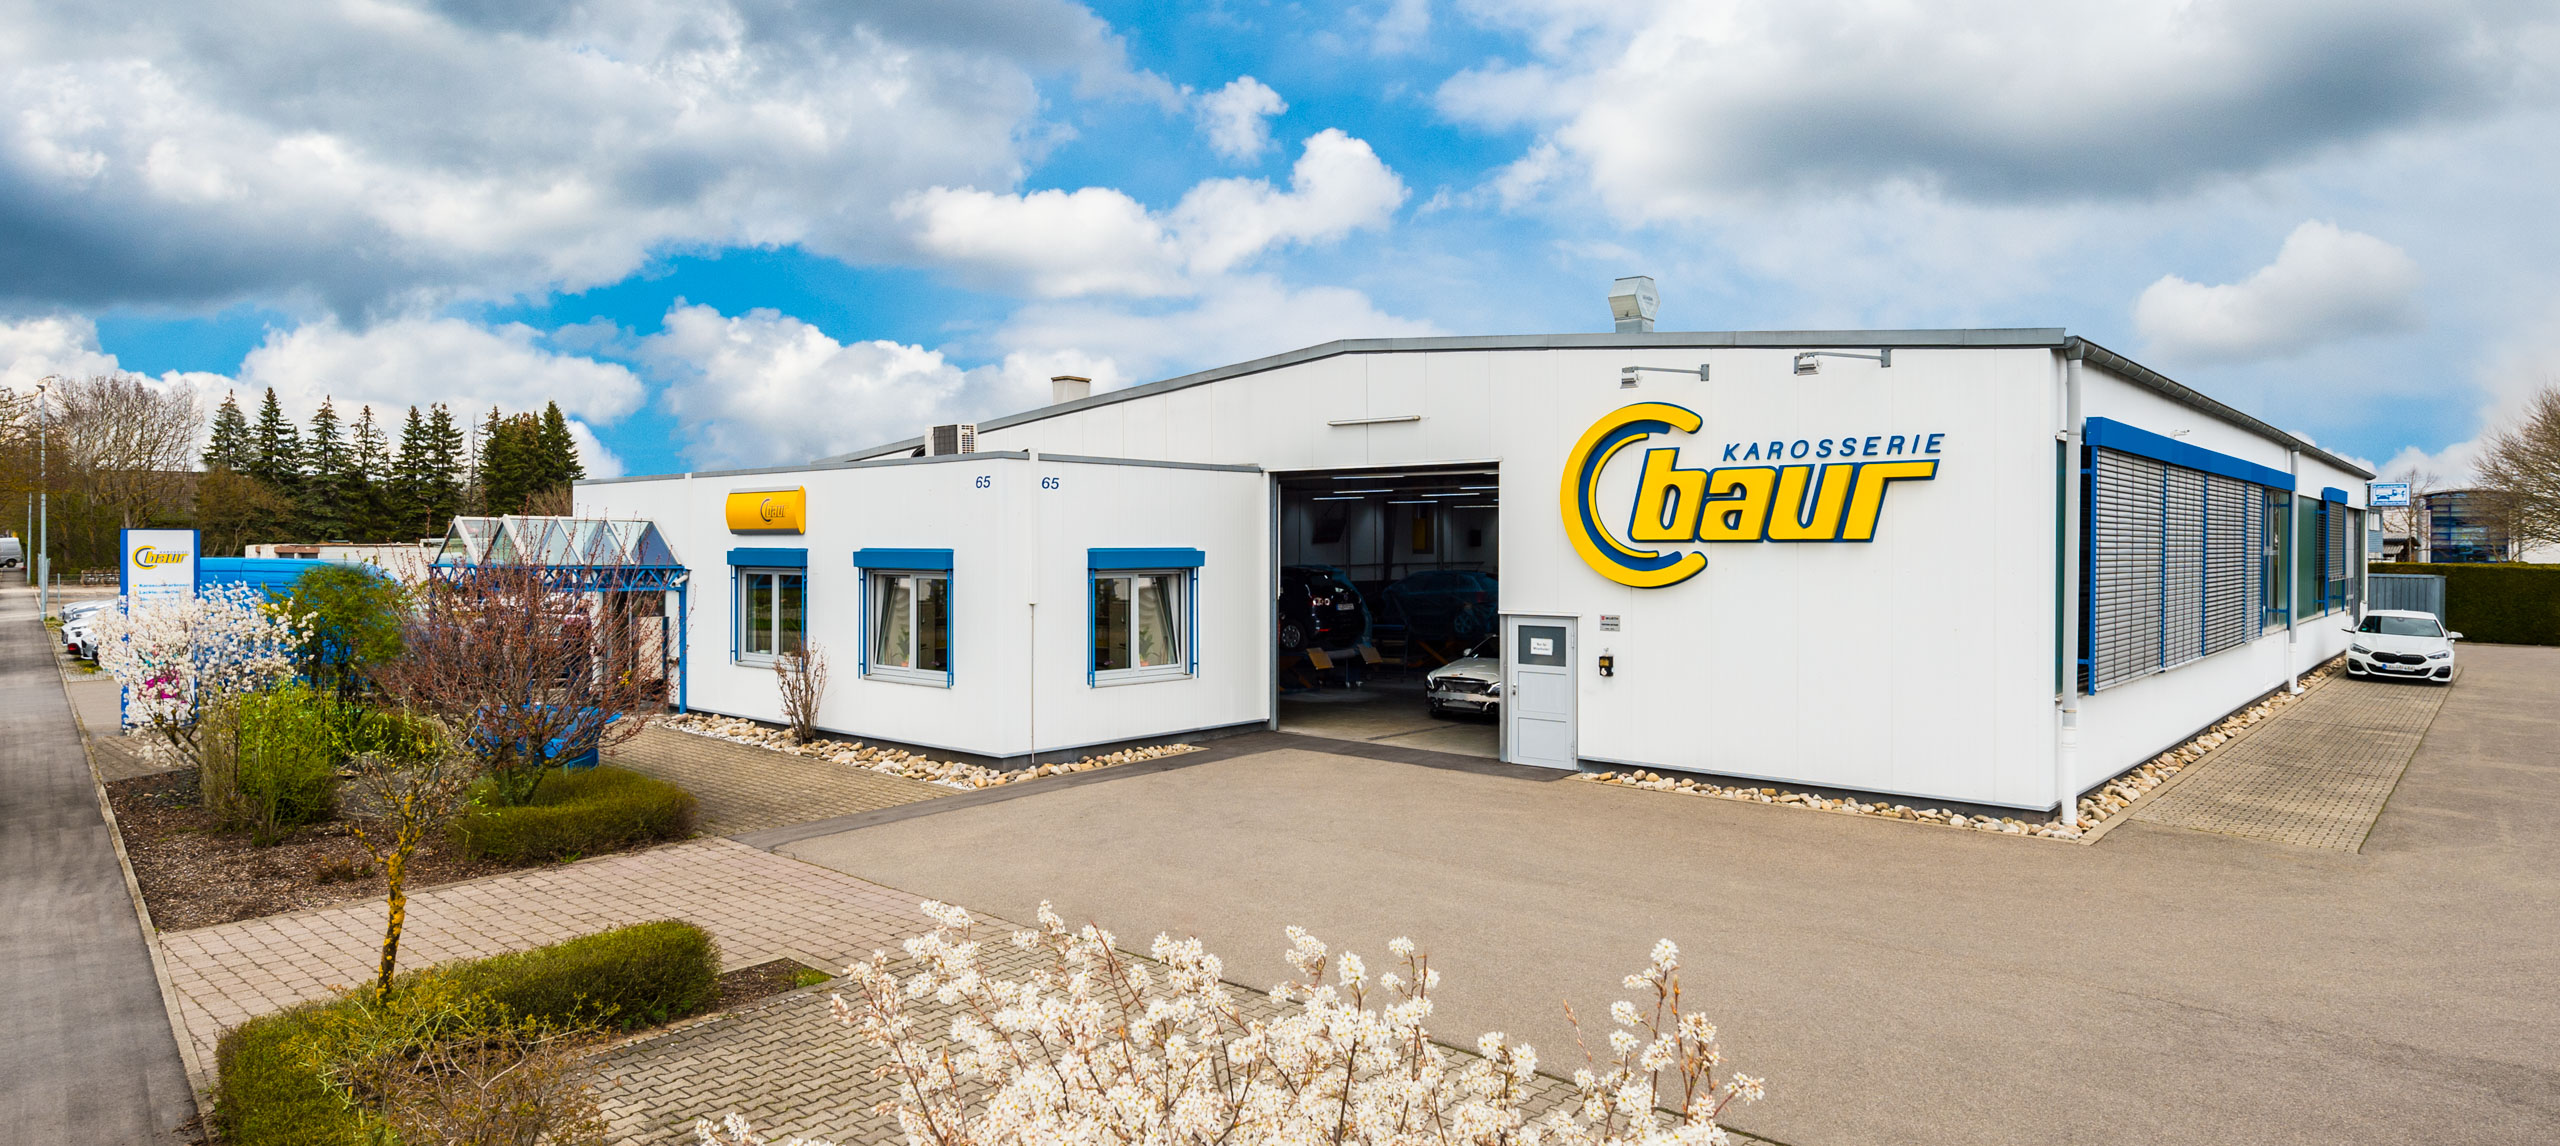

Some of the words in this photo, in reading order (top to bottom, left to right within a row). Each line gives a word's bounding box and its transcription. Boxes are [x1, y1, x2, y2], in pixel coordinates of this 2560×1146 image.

[1722, 433, 1946, 462] KAROSSERIE
[975, 475, 991, 489] 65
[1041, 476, 1060, 490] 65
